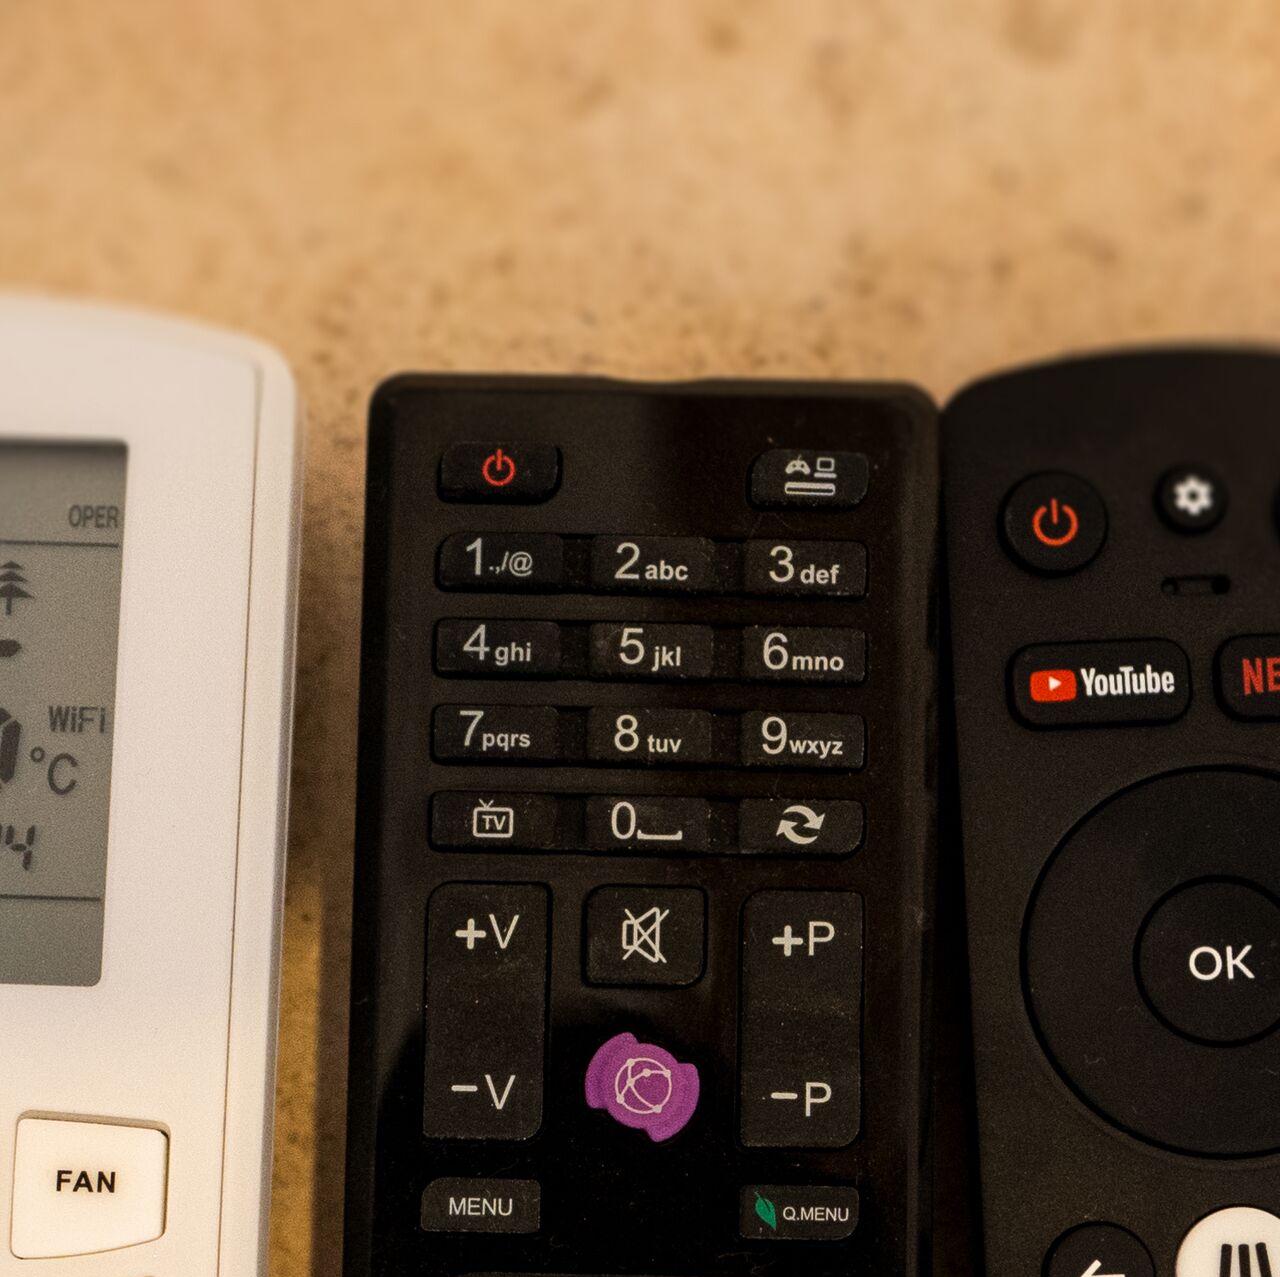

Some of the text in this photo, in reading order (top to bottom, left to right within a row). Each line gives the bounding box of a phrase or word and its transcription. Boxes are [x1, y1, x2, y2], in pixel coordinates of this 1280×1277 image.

[67, 504, 119, 530] OPER
[465, 537, 483, 576] 1
[614, 541, 689, 582] 2 abc
[768, 545, 840, 585] 3 def
[462, 623, 532, 668] 4 ghi
[619, 627, 682, 672] 5 jkl
[762, 631, 845, 672] 6 mno
[1079, 664, 1175, 697] YouTube
[48, 705, 107, 735] WiFi
[458, 710, 531, 751] 7 pqrs
[613, 713, 682, 754] 8 tuv
[761, 715, 844, 758] 9 wxyz
[481, 814, 508, 832] TV
[1188, 944, 1256, 981] OK
[55, 1169, 117, 1195] FAN
[448, 1196, 514, 1217] MENU
[781, 1205, 850, 1223] Q.MENU
